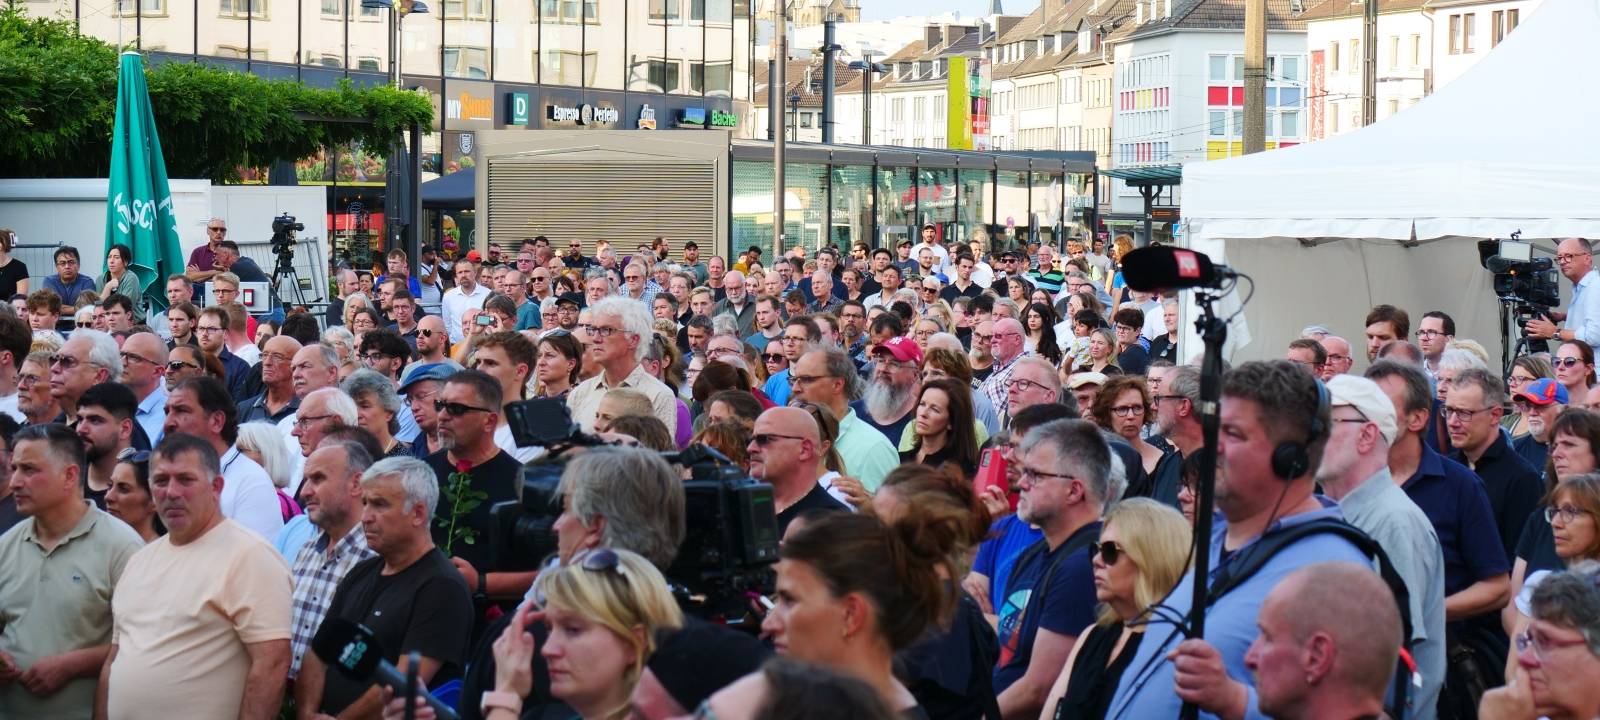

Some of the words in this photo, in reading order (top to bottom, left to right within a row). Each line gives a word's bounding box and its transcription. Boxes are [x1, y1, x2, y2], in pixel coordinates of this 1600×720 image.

[516, 96, 526, 116] D
[553, 104, 579, 121] Espresso
[593, 106, 619, 123] Perfetto
[640, 103, 655, 121] dm
